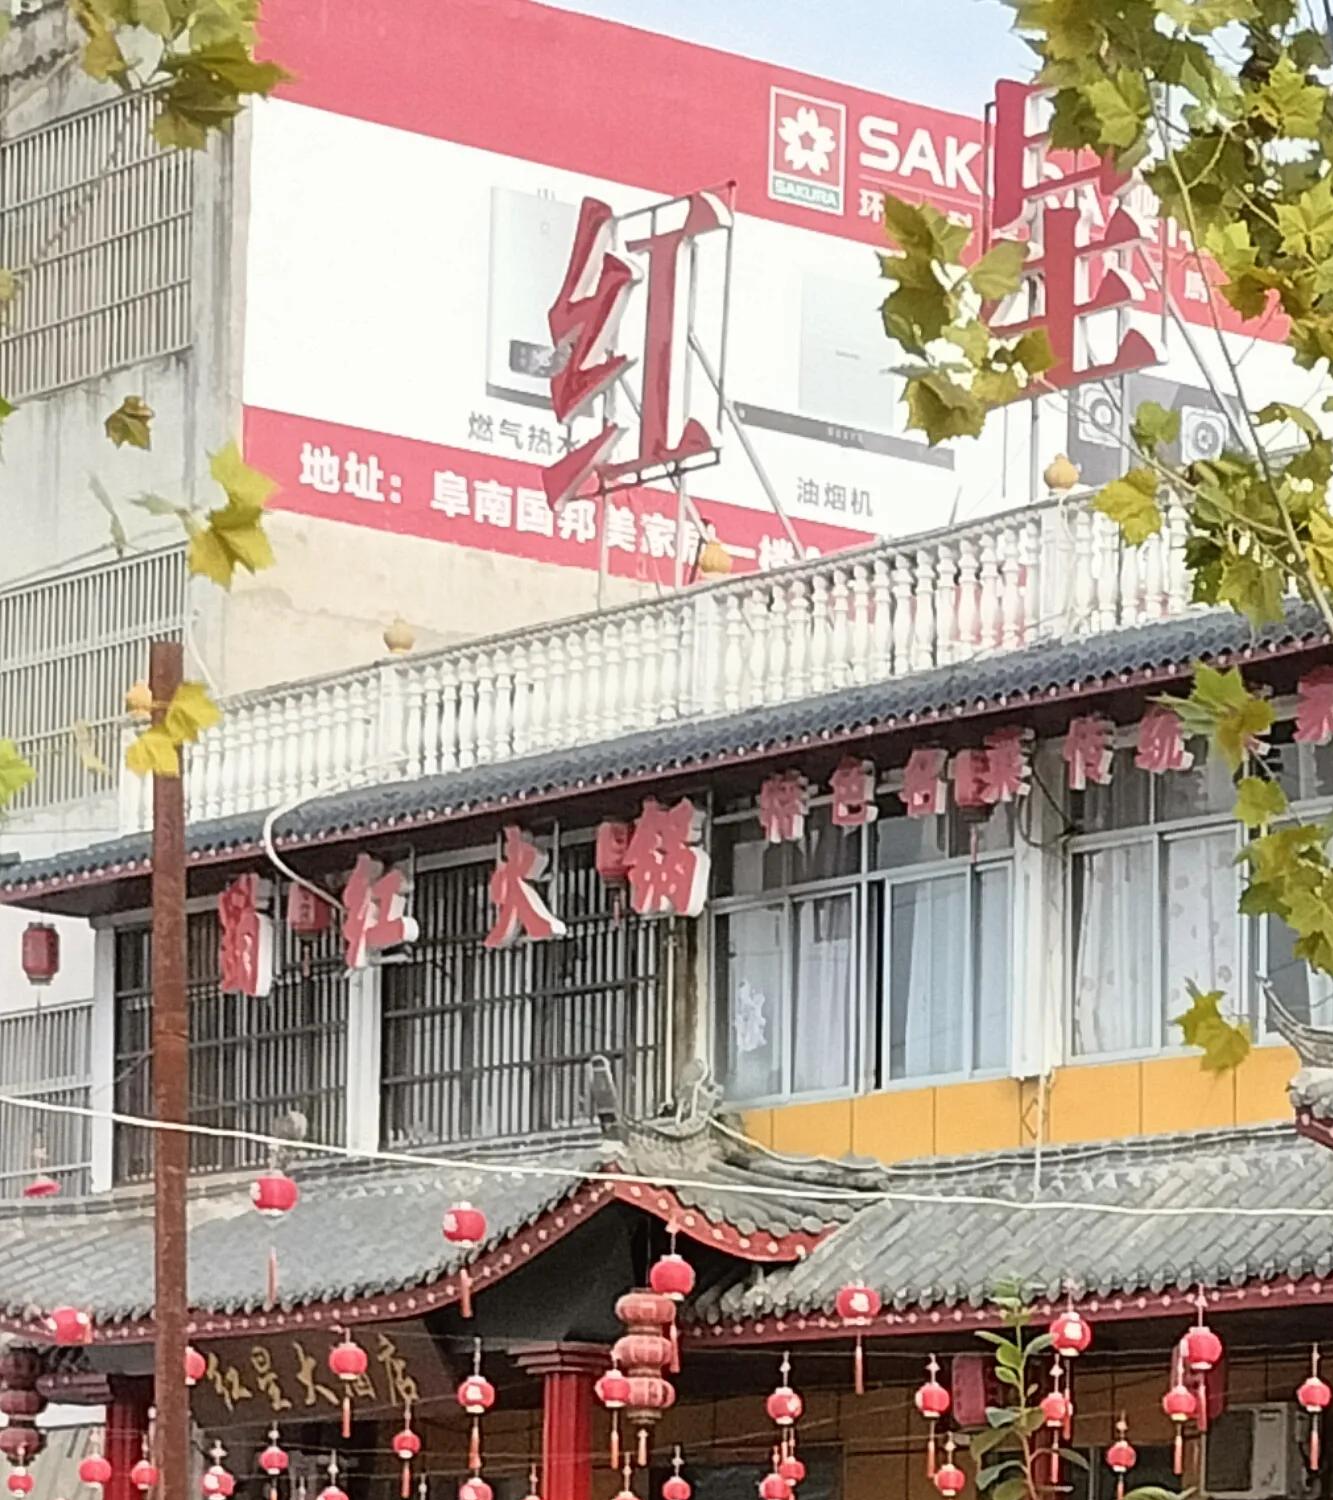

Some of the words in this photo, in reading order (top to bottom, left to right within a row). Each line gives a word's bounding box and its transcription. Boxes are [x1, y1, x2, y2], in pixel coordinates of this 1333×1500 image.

[773, 178, 839, 209] SAKURA
[796, 475, 875, 519] 油烟机
